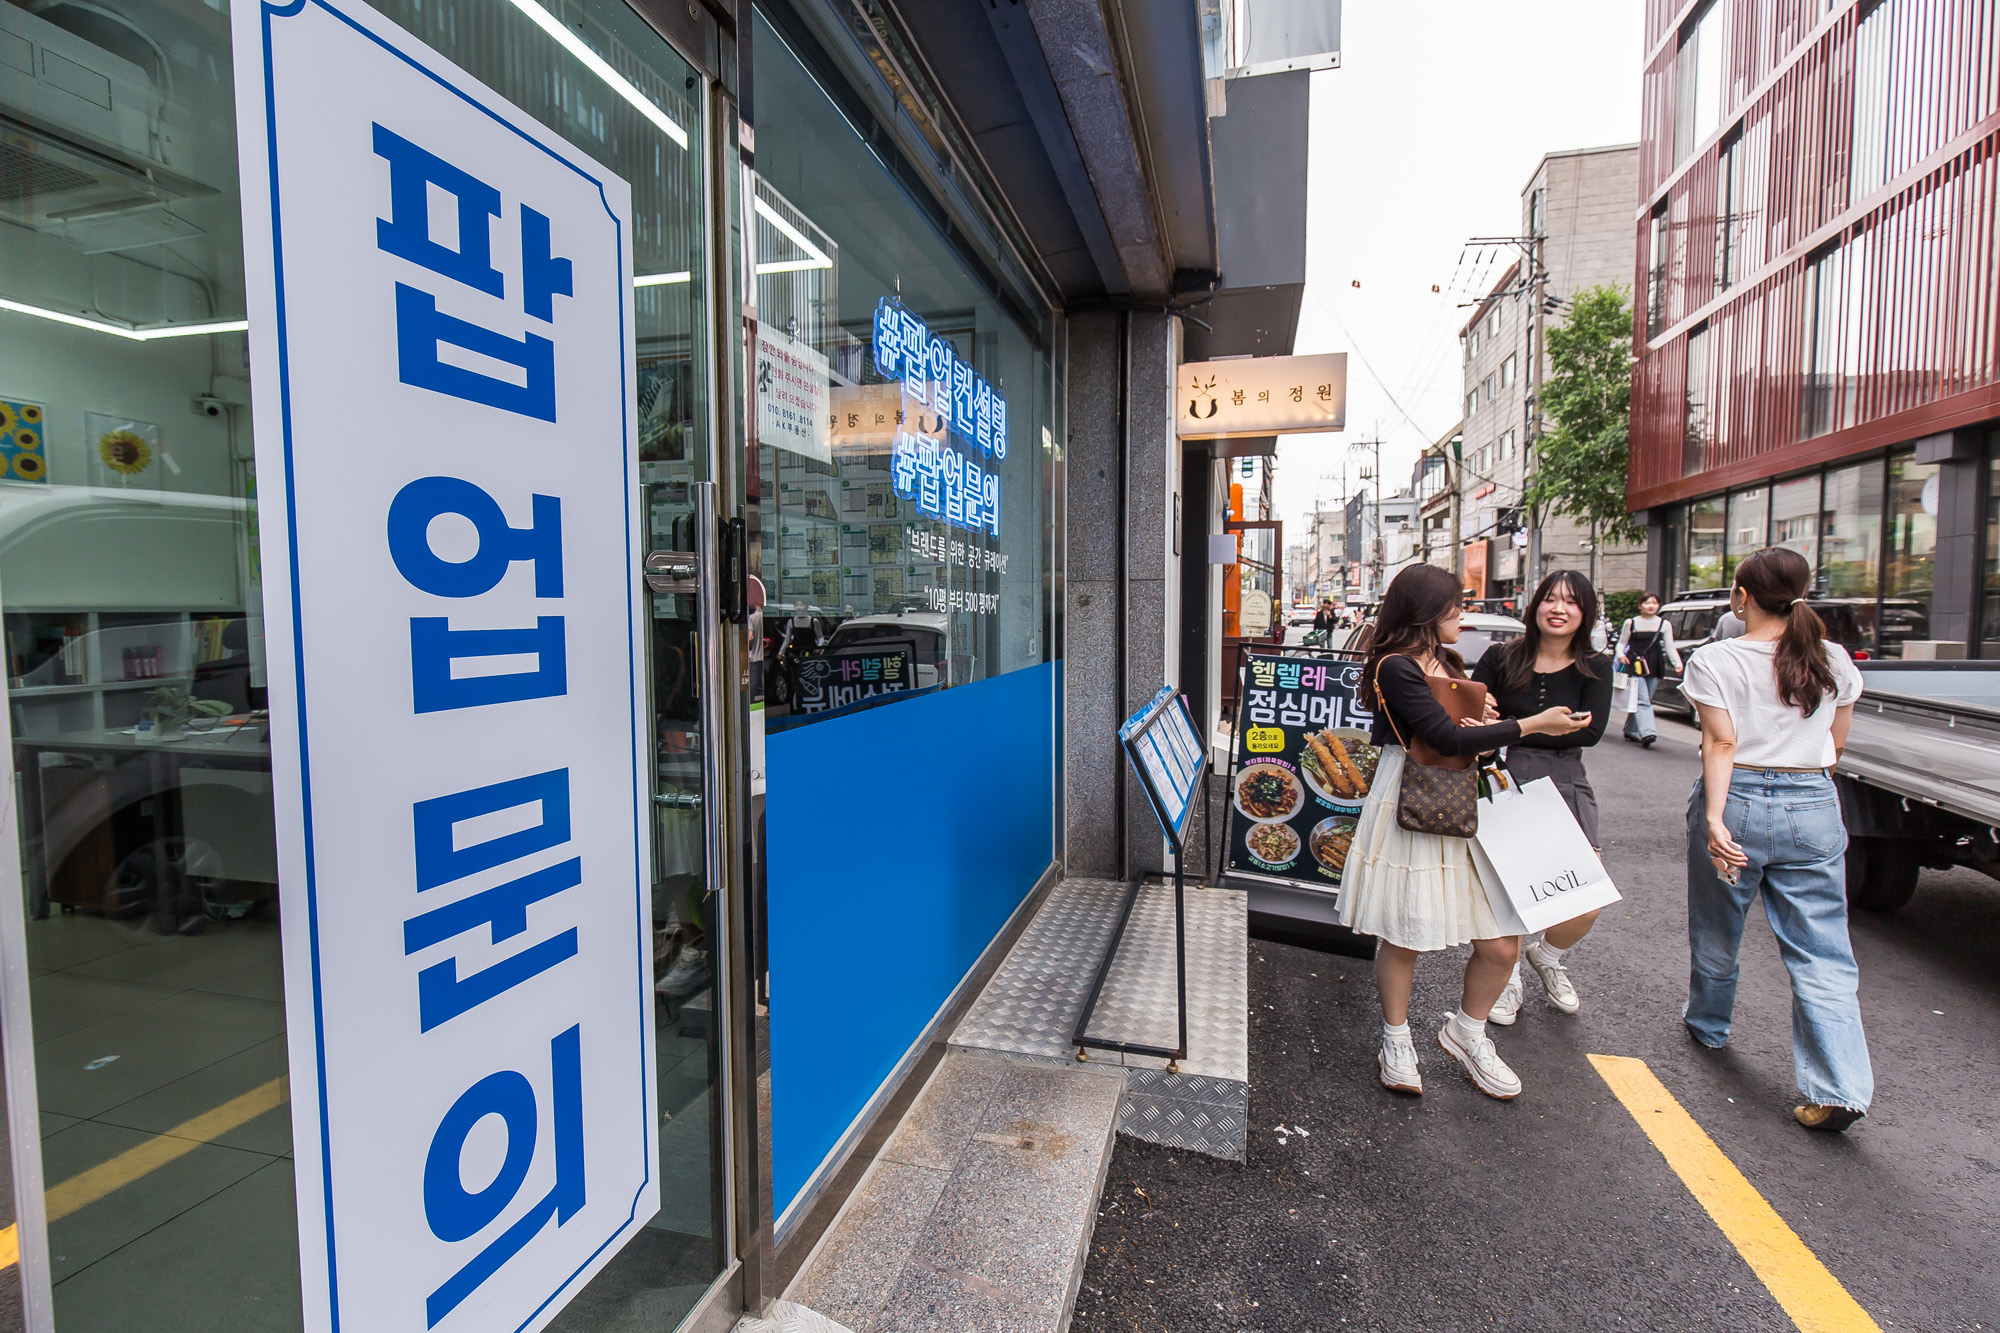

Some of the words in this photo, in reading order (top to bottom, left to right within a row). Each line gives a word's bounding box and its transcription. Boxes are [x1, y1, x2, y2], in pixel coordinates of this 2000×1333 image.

[761, 339, 776, 356] 잠깐
[771, 365, 784, 381] 전화
[785, 372, 803, 389] 주시면
[878, 305, 1007, 460] #팝업컨설팅
[775, 388, 788, 403] 달려
[896, 431, 1000, 537] #팝업문의
[950, 540, 965, 566] 위한
[968, 544, 982, 570] 공간
[949, 589, 964, 614] 부터
[1252, 659, 1327, 692] 헬렐레
[372, 121, 586, 1328] 팝업문의
[1248, 689, 1374, 733] 점심메뉴
